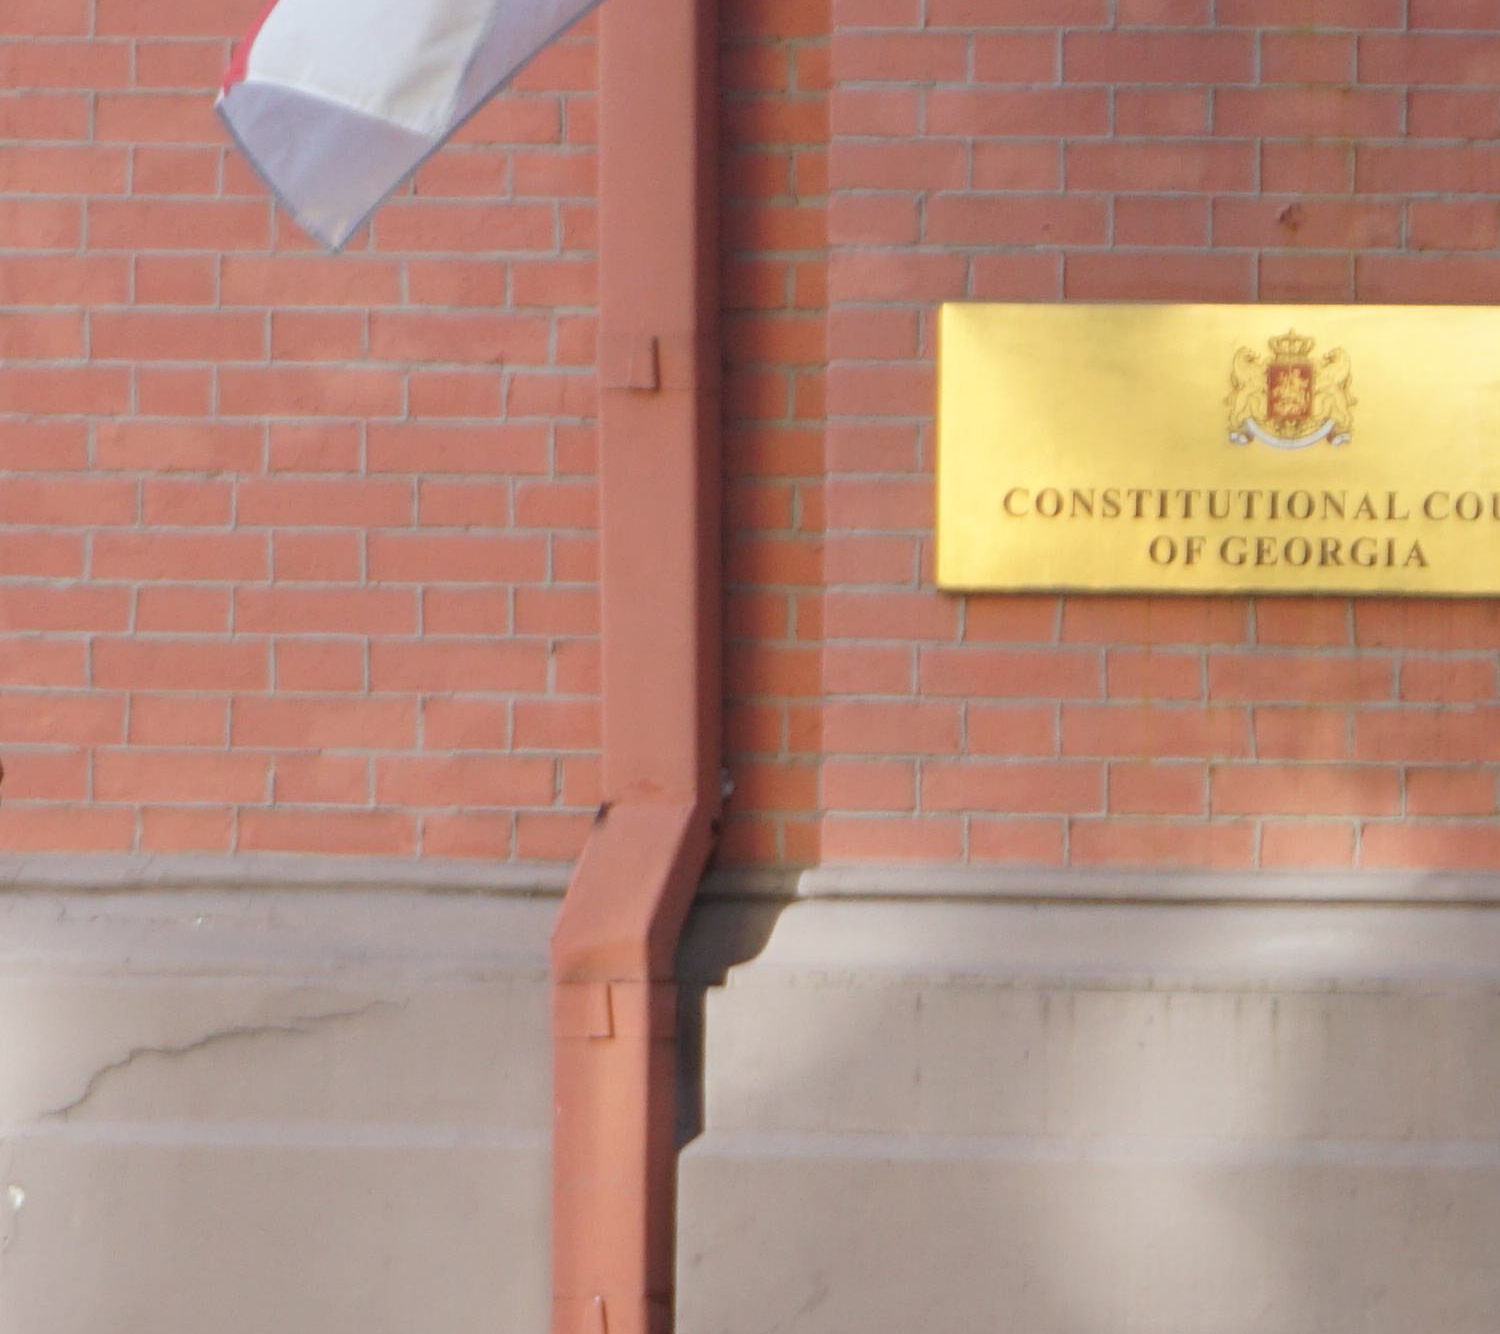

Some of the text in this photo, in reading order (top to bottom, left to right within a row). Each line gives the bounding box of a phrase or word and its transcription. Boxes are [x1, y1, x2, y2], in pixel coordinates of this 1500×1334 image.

[1002, 487, 1410, 521] CONSTITUTIONAL
[1148, 535, 1429, 569] OF GEORGIA
